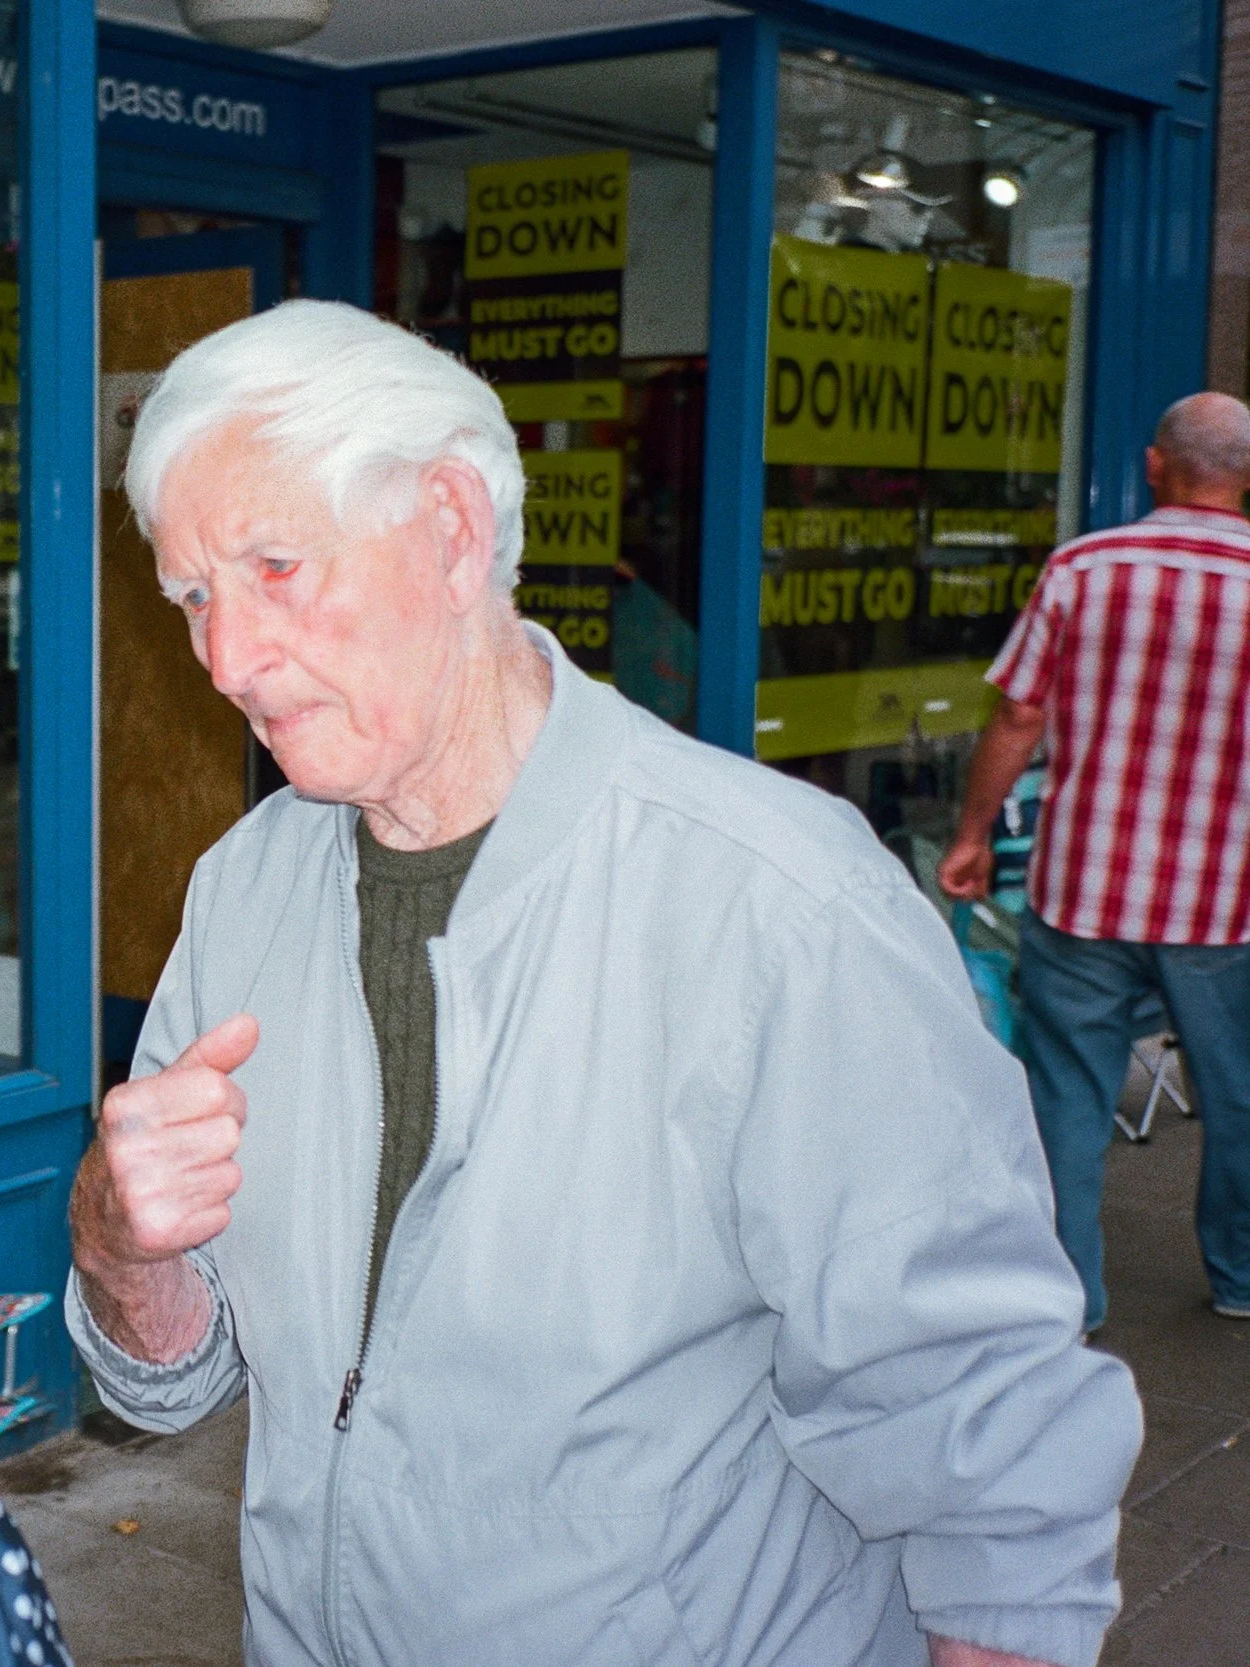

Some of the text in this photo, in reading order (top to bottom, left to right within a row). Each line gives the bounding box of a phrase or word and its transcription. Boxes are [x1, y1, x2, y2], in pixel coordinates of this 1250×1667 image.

[478, 174, 618, 212] CLOSING
[477, 215, 617, 259] DOWN
[471, 292, 617, 323] EVERYTHING
[779, 279, 919, 342] CLOSING
[470, 323, 617, 362] MUST GO
[775, 359, 916, 433] DOWN
[941, 371, 1063, 442] DOWN
[530, 473, 611, 499] SING
[524, 511, 609, 546] WN
[761, 567, 914, 626] MUST GO
[558, 616, 608, 648] GO
